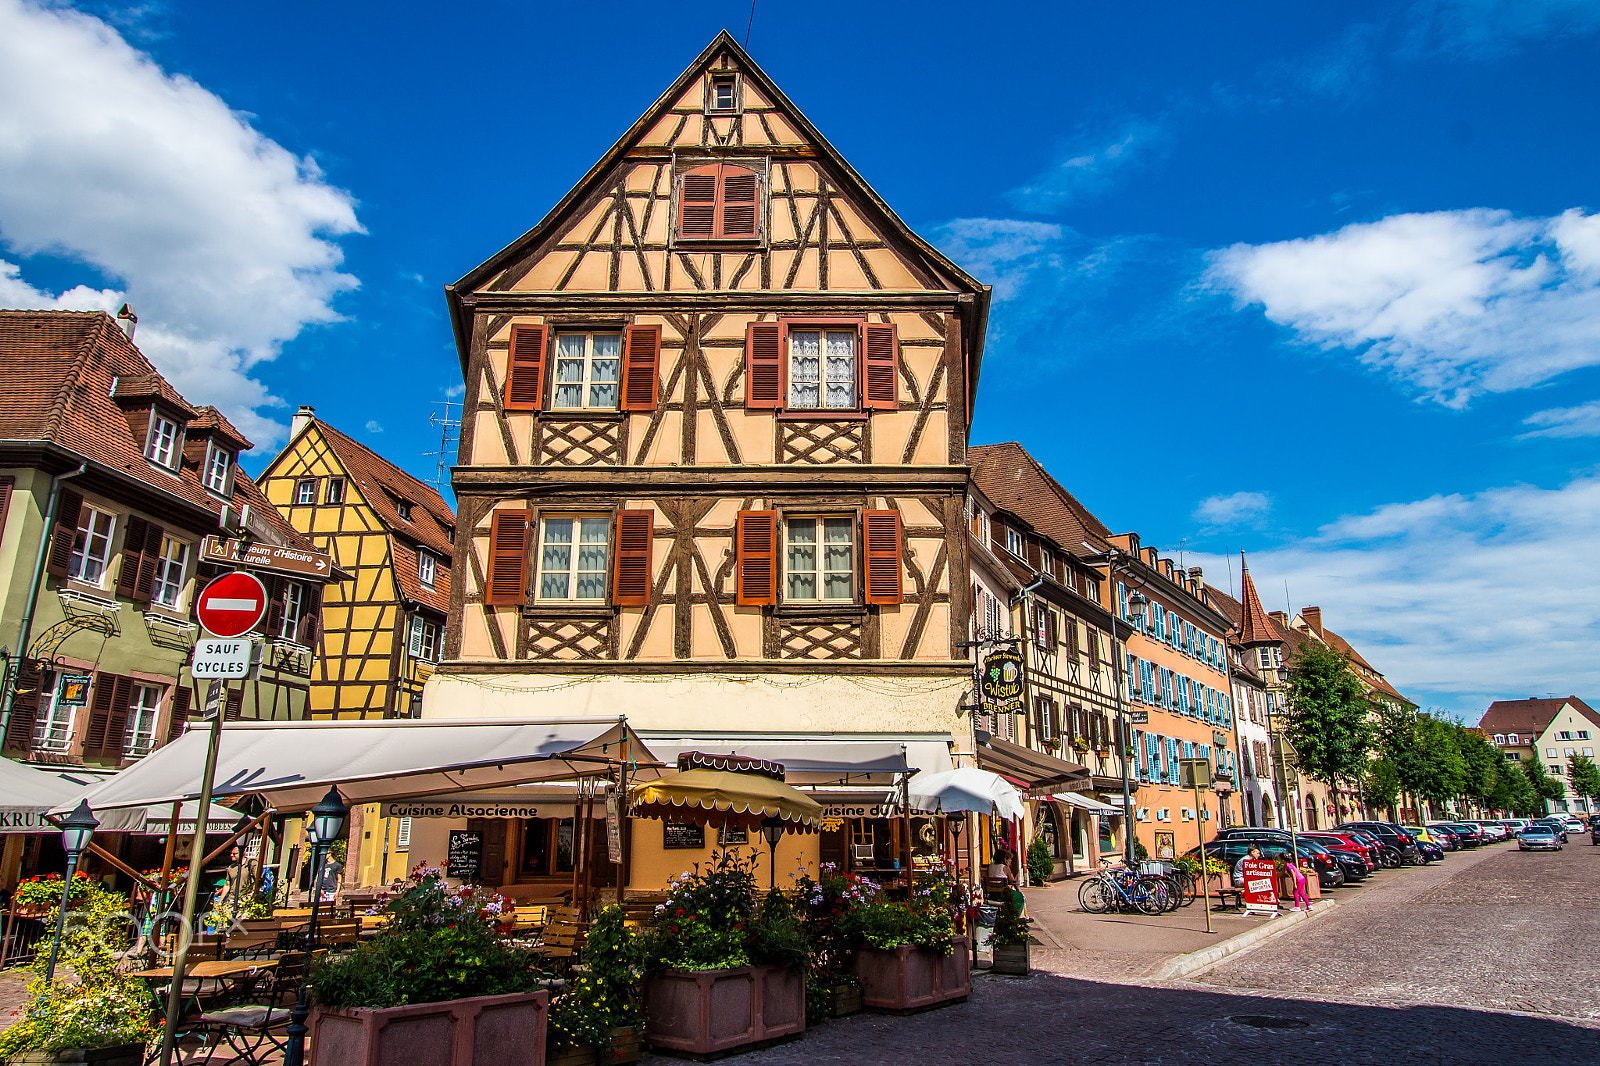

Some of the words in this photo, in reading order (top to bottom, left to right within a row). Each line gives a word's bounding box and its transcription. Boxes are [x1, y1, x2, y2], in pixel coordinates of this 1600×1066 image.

[231, 552, 271, 565] Naturelle
[273, 549, 313, 563] d'Histoire
[206, 644, 240, 654] SAUF
[196, 662, 244, 673] CYCLES
[984, 681, 1020, 698] Wistub
[983, 701, 1020, 713] BRENNER
[389, 803, 444, 816] Cuisine
[448, 803, 538, 817] Alsacienne
[822, 804, 865, 816] uisine
[1258, 862, 1274, 870] Gras
